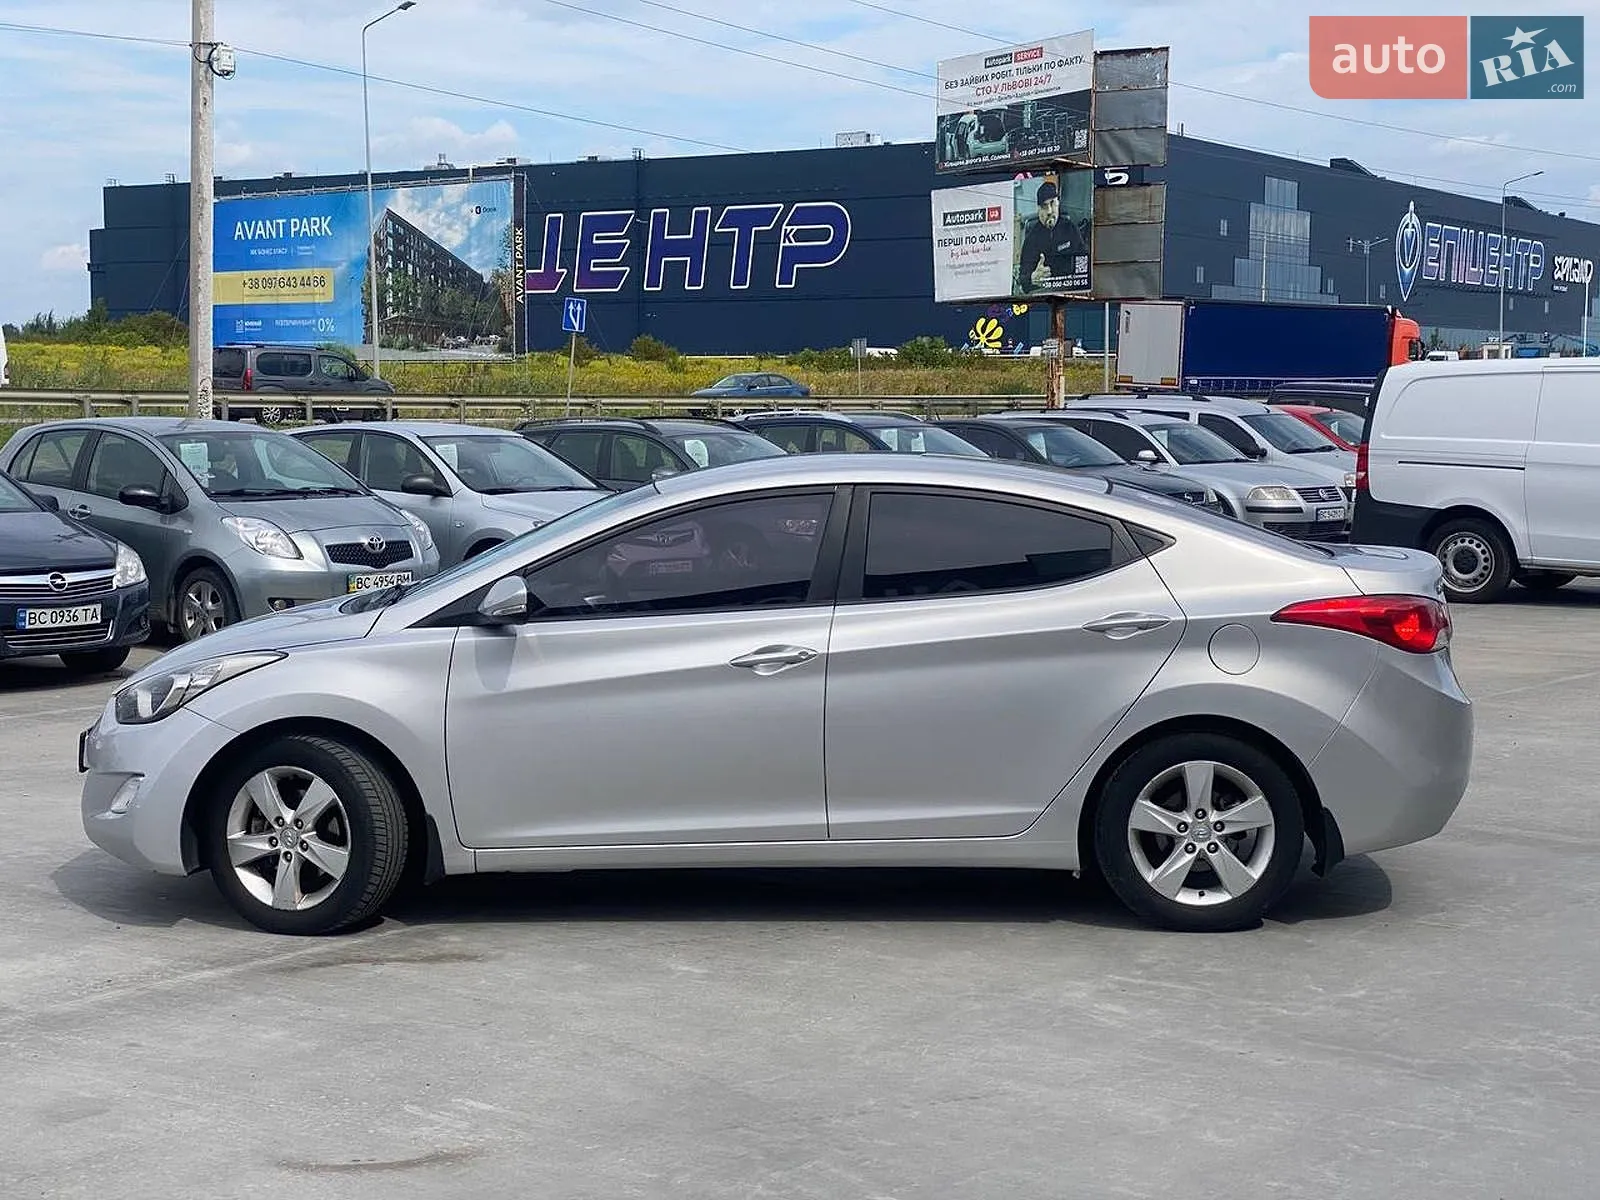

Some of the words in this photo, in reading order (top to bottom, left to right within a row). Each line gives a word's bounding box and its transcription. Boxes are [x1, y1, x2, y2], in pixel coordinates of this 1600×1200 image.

[1016, 49, 1041, 61] SERVICE
[945, 80, 958, 89] БЕЗ
[960, 73, 989, 87] ЗАЙВИХ
[1016, 65, 1042, 76] ТІЛЬКИ
[1044, 61, 1056, 71] ПО
[1057, 56, 1085, 68] ФАКТУ.
[976, 86, 991, 96] СТО
[1001, 79, 1032, 91] ЛЬВОВІ
[1034, 73, 1052, 85] 24/7
[945, 209, 983, 224] Autopark
[234, 219, 287, 240] AVANT
[290, 215, 333, 238] PARK
[515, 227, 523, 260] PARK
[937, 237, 963, 248] ПЕРШІ
[965, 236, 977, 244] ПО
[979, 232, 1008, 243] ФАКТУ.
[1422, 222, 1545, 291] ЕПІЦЕНТР
[242, 277, 259, 289] +38
[261, 277, 278, 289] 097
[278, 276, 298, 289] 643
[300, 276, 311, 288] 44
[313, 275, 326, 288] 66
[516, 262, 524, 304] AVANT
[318, 317, 337, 333] 0%
[356, 576, 371, 589] BC
[373, 575, 395, 588] 4954
[28, 611, 47, 625] BC
[50, 609, 79, 624] 0936
[82, 607, 99, 621] TA
